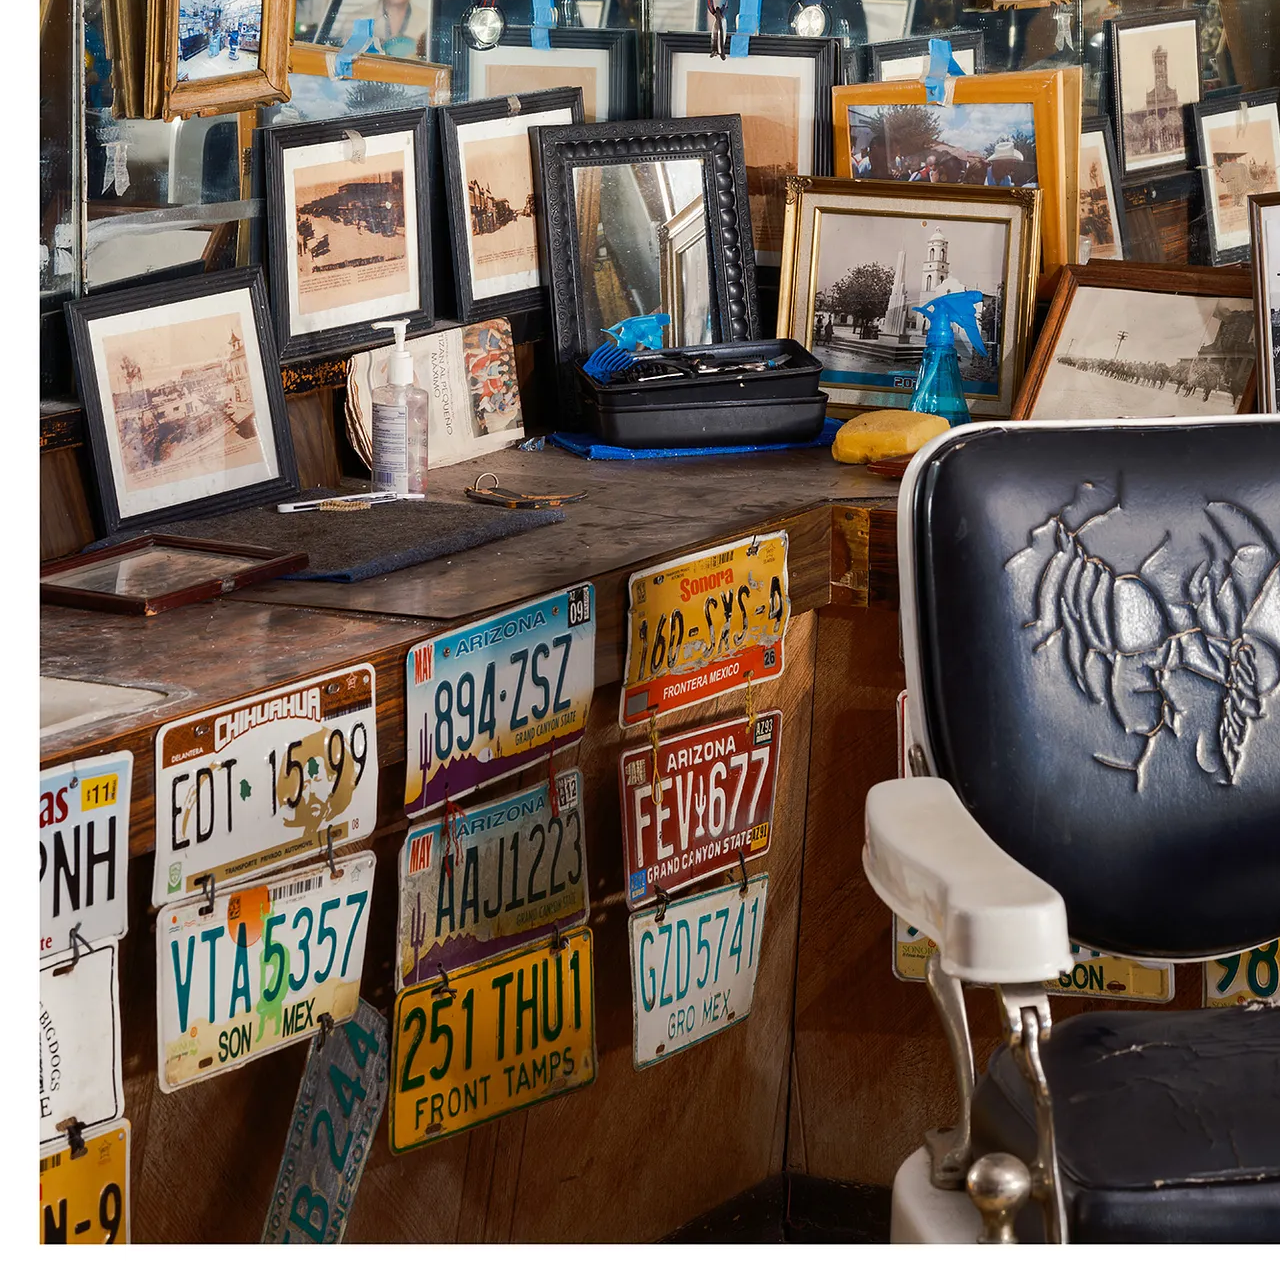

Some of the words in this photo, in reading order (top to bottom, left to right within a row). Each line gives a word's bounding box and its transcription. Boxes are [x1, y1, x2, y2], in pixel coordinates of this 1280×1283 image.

[680, 567, 735, 602] Sonora
[570, 600, 584, 624] 09
[454, 610, 547, 659] ARIZONA
[414, 645, 433, 685] MAY
[764, 650, 776, 666] 26
[663, 673, 709, 700] FRONTERA
[709, 662, 740, 684] MEXICO
[213, 687, 322, 754] CHIHUAHUA
[515, 728, 536, 747] GRAND
[536, 718, 559, 738] CANYON
[560, 710, 577, 728] STATE
[755, 718, 773, 736] AZ93
[171, 747, 204, 764] DELANTERA
[666, 735, 737, 773] ARIZONA
[92, 781, 112, 805] 11
[172, 758, 238, 852] EDT
[456, 795, 546, 839] ARIZONA
[40, 815, 117, 918] NH
[224, 859, 259, 875] TRANSPORTE
[260, 850, 282, 864] PRIVADO
[409, 833, 433, 875] MAY
[435, 808, 582, 938] AAJ1223
[647, 858, 680, 884] GRAND
[681, 840, 722, 870] CANYON
[722, 828, 752, 855] STATE
[639, 897, 759, 1013] GZD5741
[218, 1022, 253, 1063] SON
[282, 997, 316, 1038] MEX
[400, 987, 475, 1093] 251
[491, 949, 582, 1062] THU1
[667, 1005, 696, 1040] GRO
[701, 989, 731, 1027] MEX
[414, 1074, 492, 1131] FRONT
[503, 1046, 575, 1098] TAMPS
